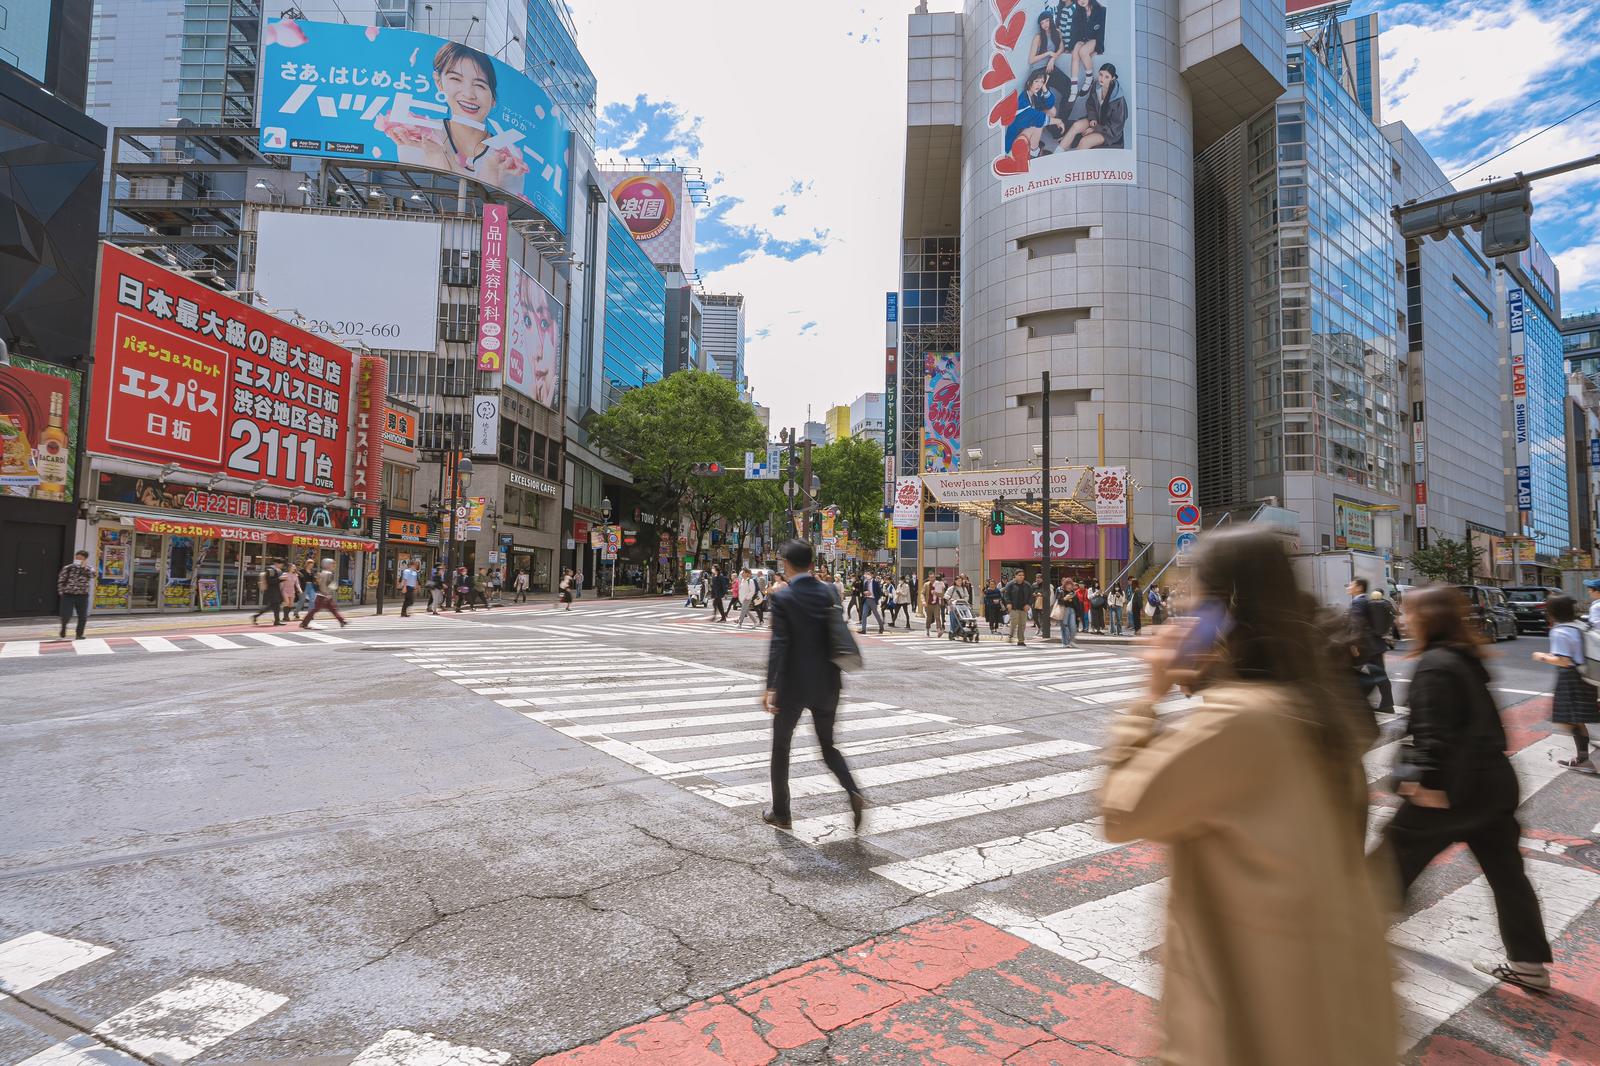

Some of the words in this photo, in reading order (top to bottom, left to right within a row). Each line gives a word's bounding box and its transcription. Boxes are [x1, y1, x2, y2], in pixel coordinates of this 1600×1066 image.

[280, 61, 430, 93] さあ、はじめよう
[1004, 184, 1025, 198] 45th
[1027, 176, 1062, 191] Anniv.
[1064, 170, 1134, 183] SHIBUYA109
[621, 197, 665, 220] 楽園
[635, 217, 672, 241] AMUSEMENT
[483, 225, 503, 321] 品川美容外科
[116, 273, 342, 387] 日本最大級の超大型店
[1511, 301, 1524, 332] LABI
[123, 335, 221, 379] パチンコ&スロット
[118, 366, 219, 418] エスパス
[233, 357, 340, 415] エスパス日拓
[1512, 364, 1525, 396] LABI
[147, 413, 192, 443] 日拓
[232, 388, 339, 441] 渋谷地区合計
[385, 411, 407, 434] 野家
[1516, 403, 1525, 443] SHIBUYA
[383, 432, 407, 446] SHINOYA
[314, 477, 334, 489] OVER
[510, 472, 540, 491] EXCELSIOR
[940, 479, 989, 489] NewJeans
[999, 475, 1067, 486] SHIBUY109
[960, 488, 1019, 497] ANNIVERSARY
[1020, 486, 1068, 495] CAMIGN
[1173, 482, 1187, 493] 30
[1519, 479, 1531, 509] LABI
[641, 512, 654, 525] TOHO
